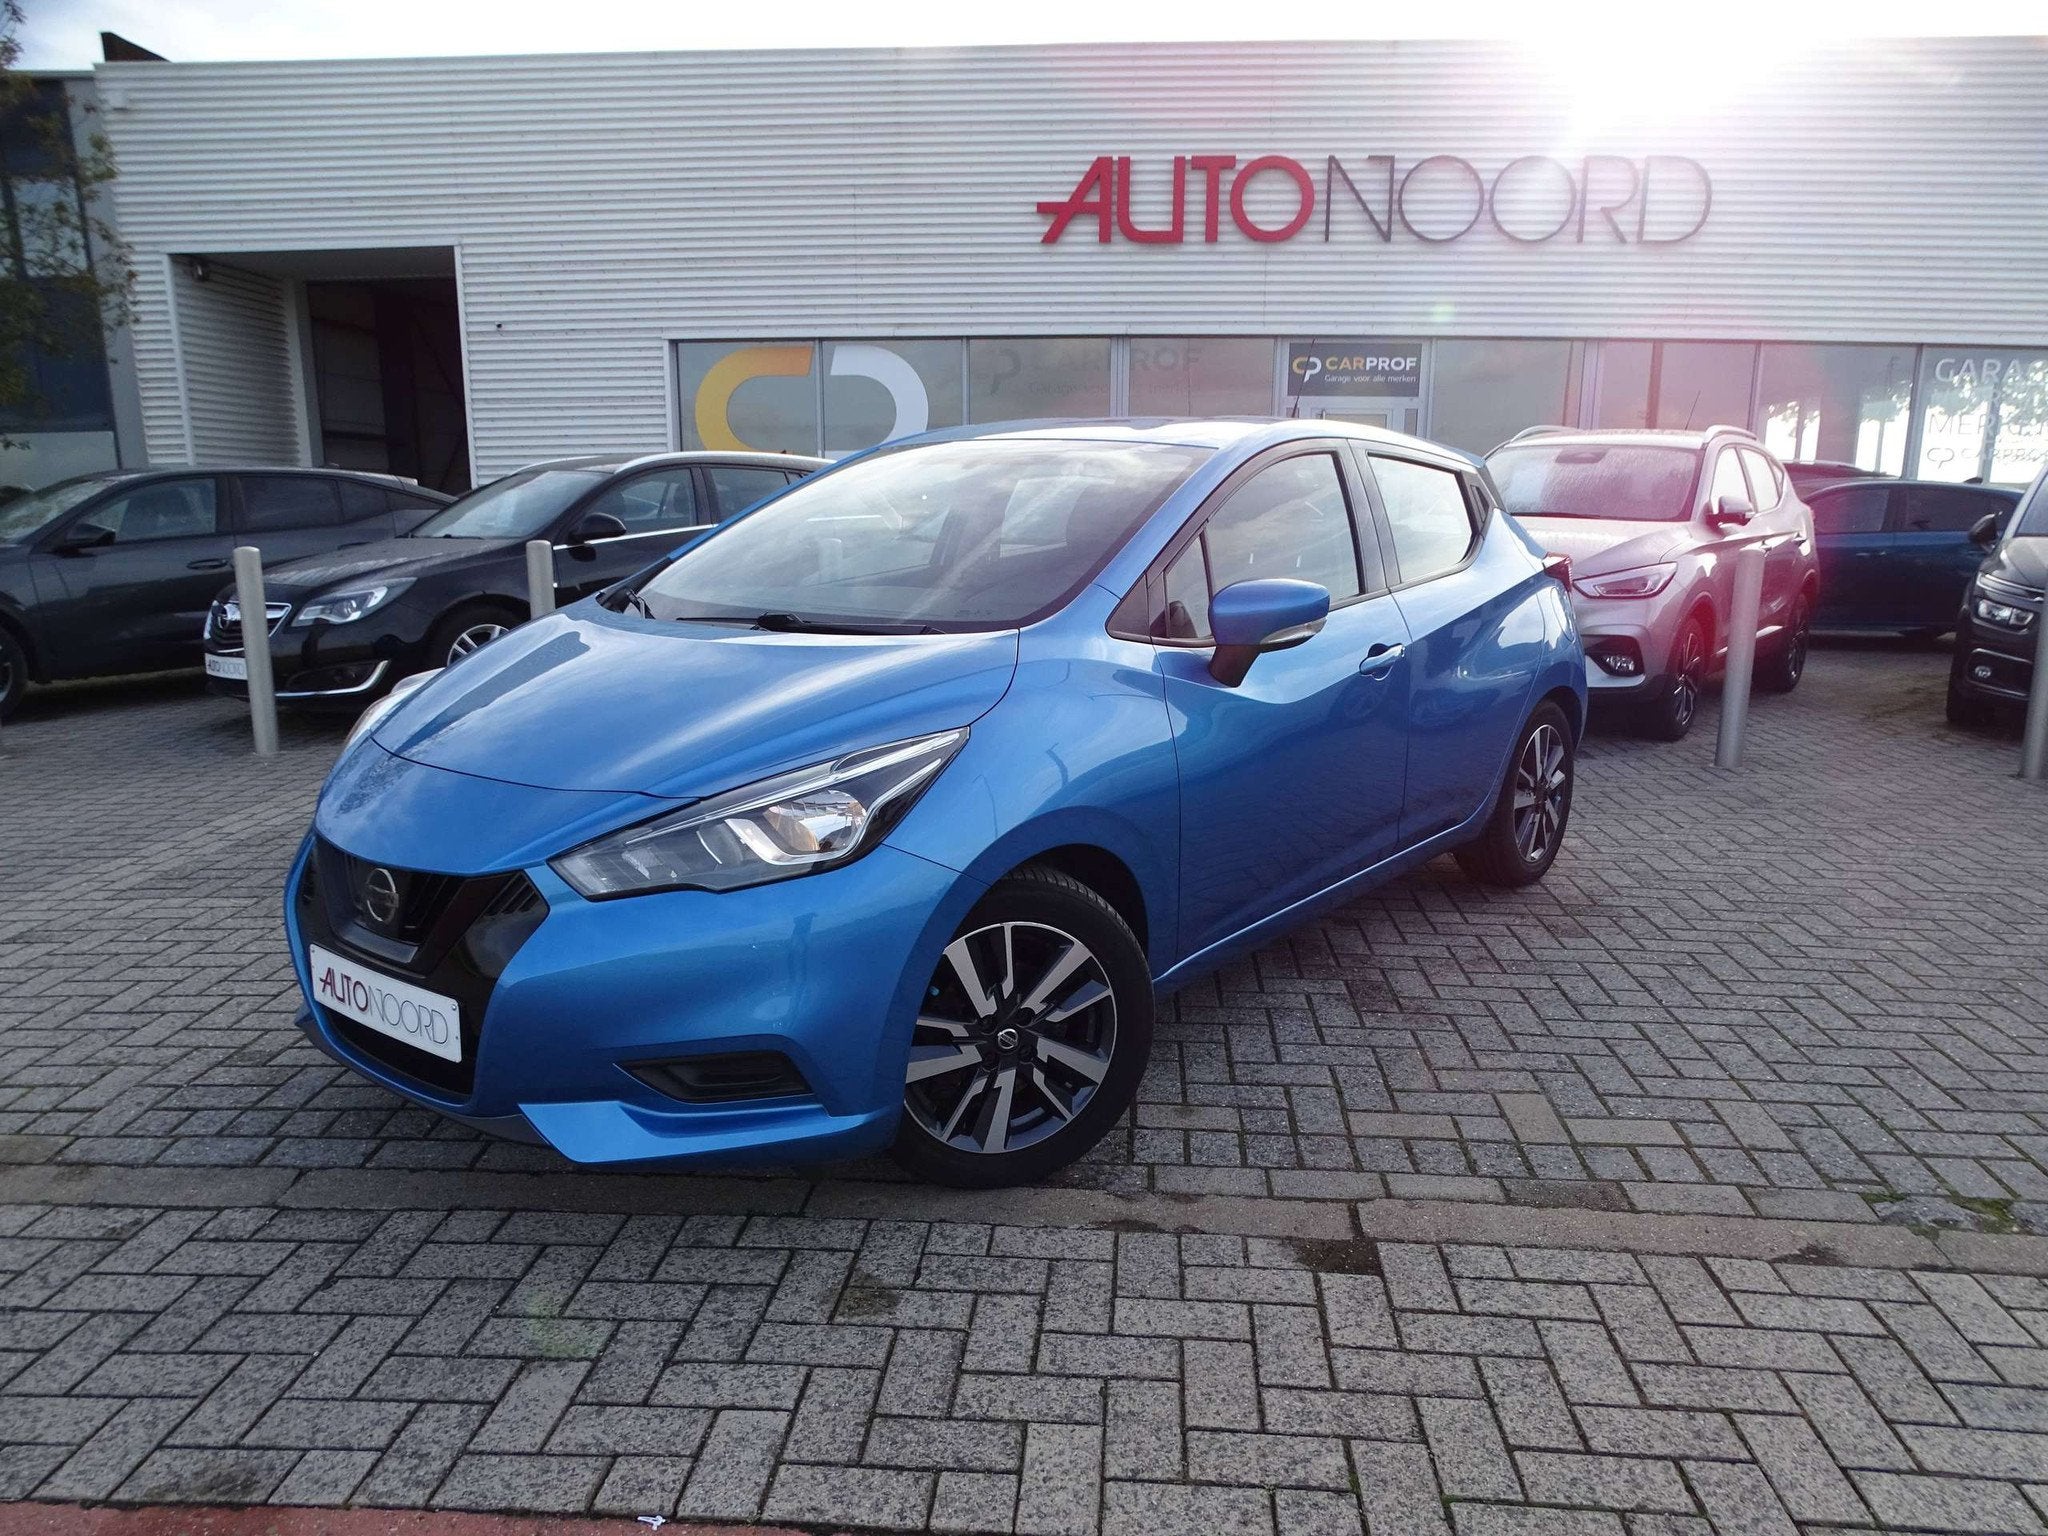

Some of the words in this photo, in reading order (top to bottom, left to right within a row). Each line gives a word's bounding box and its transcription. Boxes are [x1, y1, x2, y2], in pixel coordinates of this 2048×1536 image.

[1036, 154, 1713, 245] AUTONOORD
[1324, 374, 1350, 384] Garage
[1353, 375, 1370, 383] voor
[1373, 374, 1386, 383] alle
[1388, 374, 1417, 383] merken
[1325, 356, 1417, 371] CARPROF
[319, 966, 449, 1045] AUTONOORD
